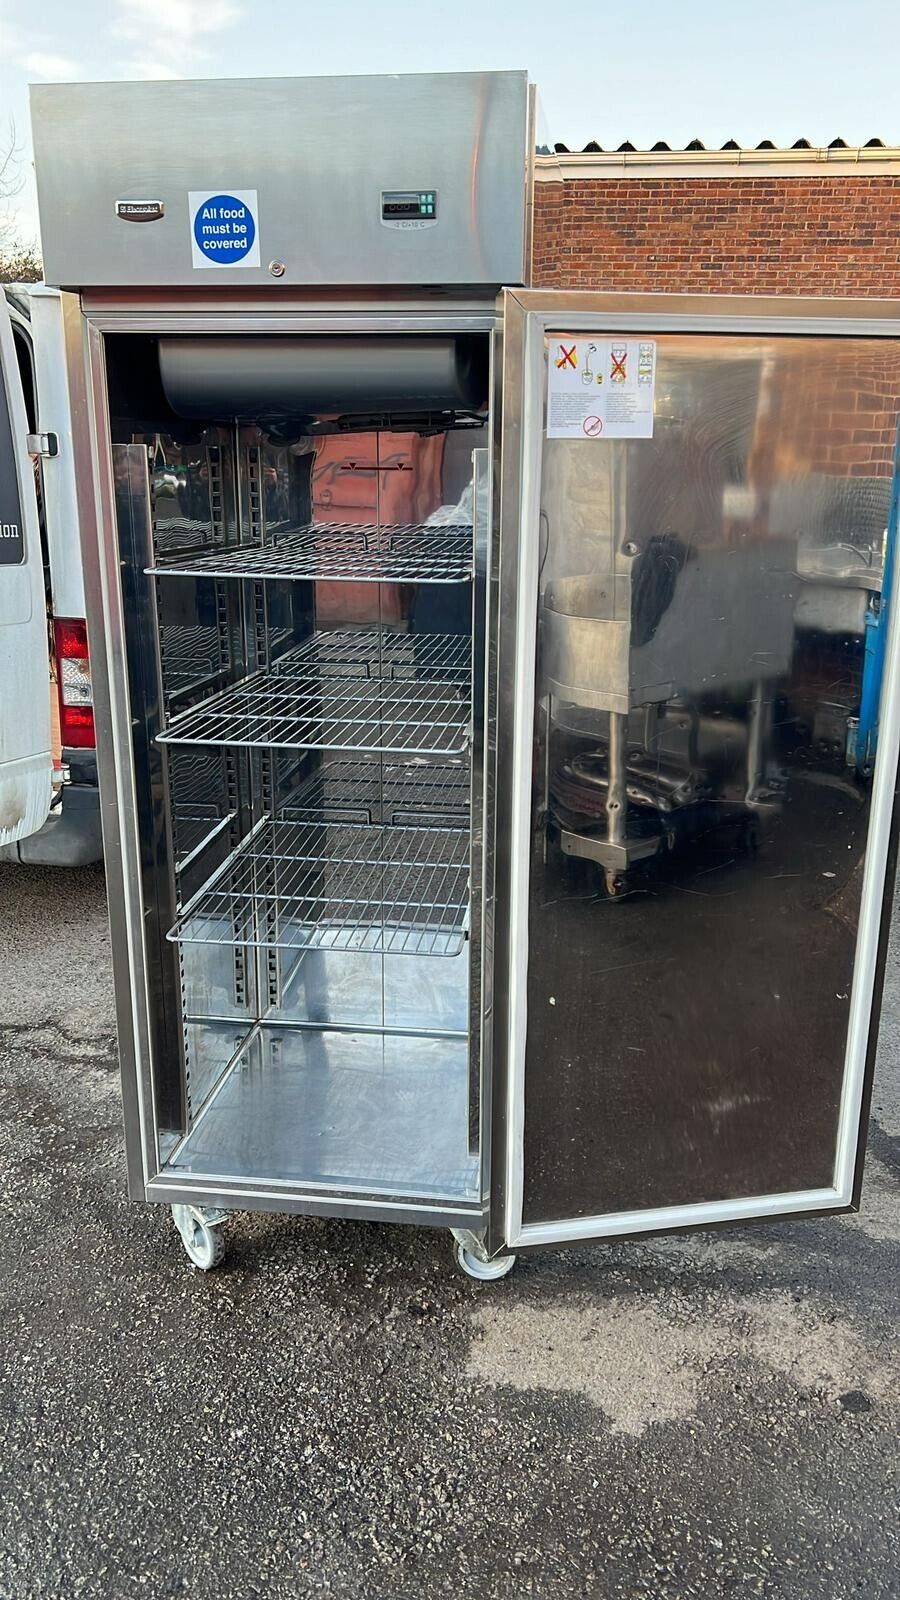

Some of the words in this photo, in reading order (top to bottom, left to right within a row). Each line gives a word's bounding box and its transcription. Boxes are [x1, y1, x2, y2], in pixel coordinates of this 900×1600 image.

[202, 207, 217, 219] All
[219, 207, 246, 219] food
[202, 223, 231, 235] must
[232, 222, 247, 234] be
[203, 237, 248, 250] covered
